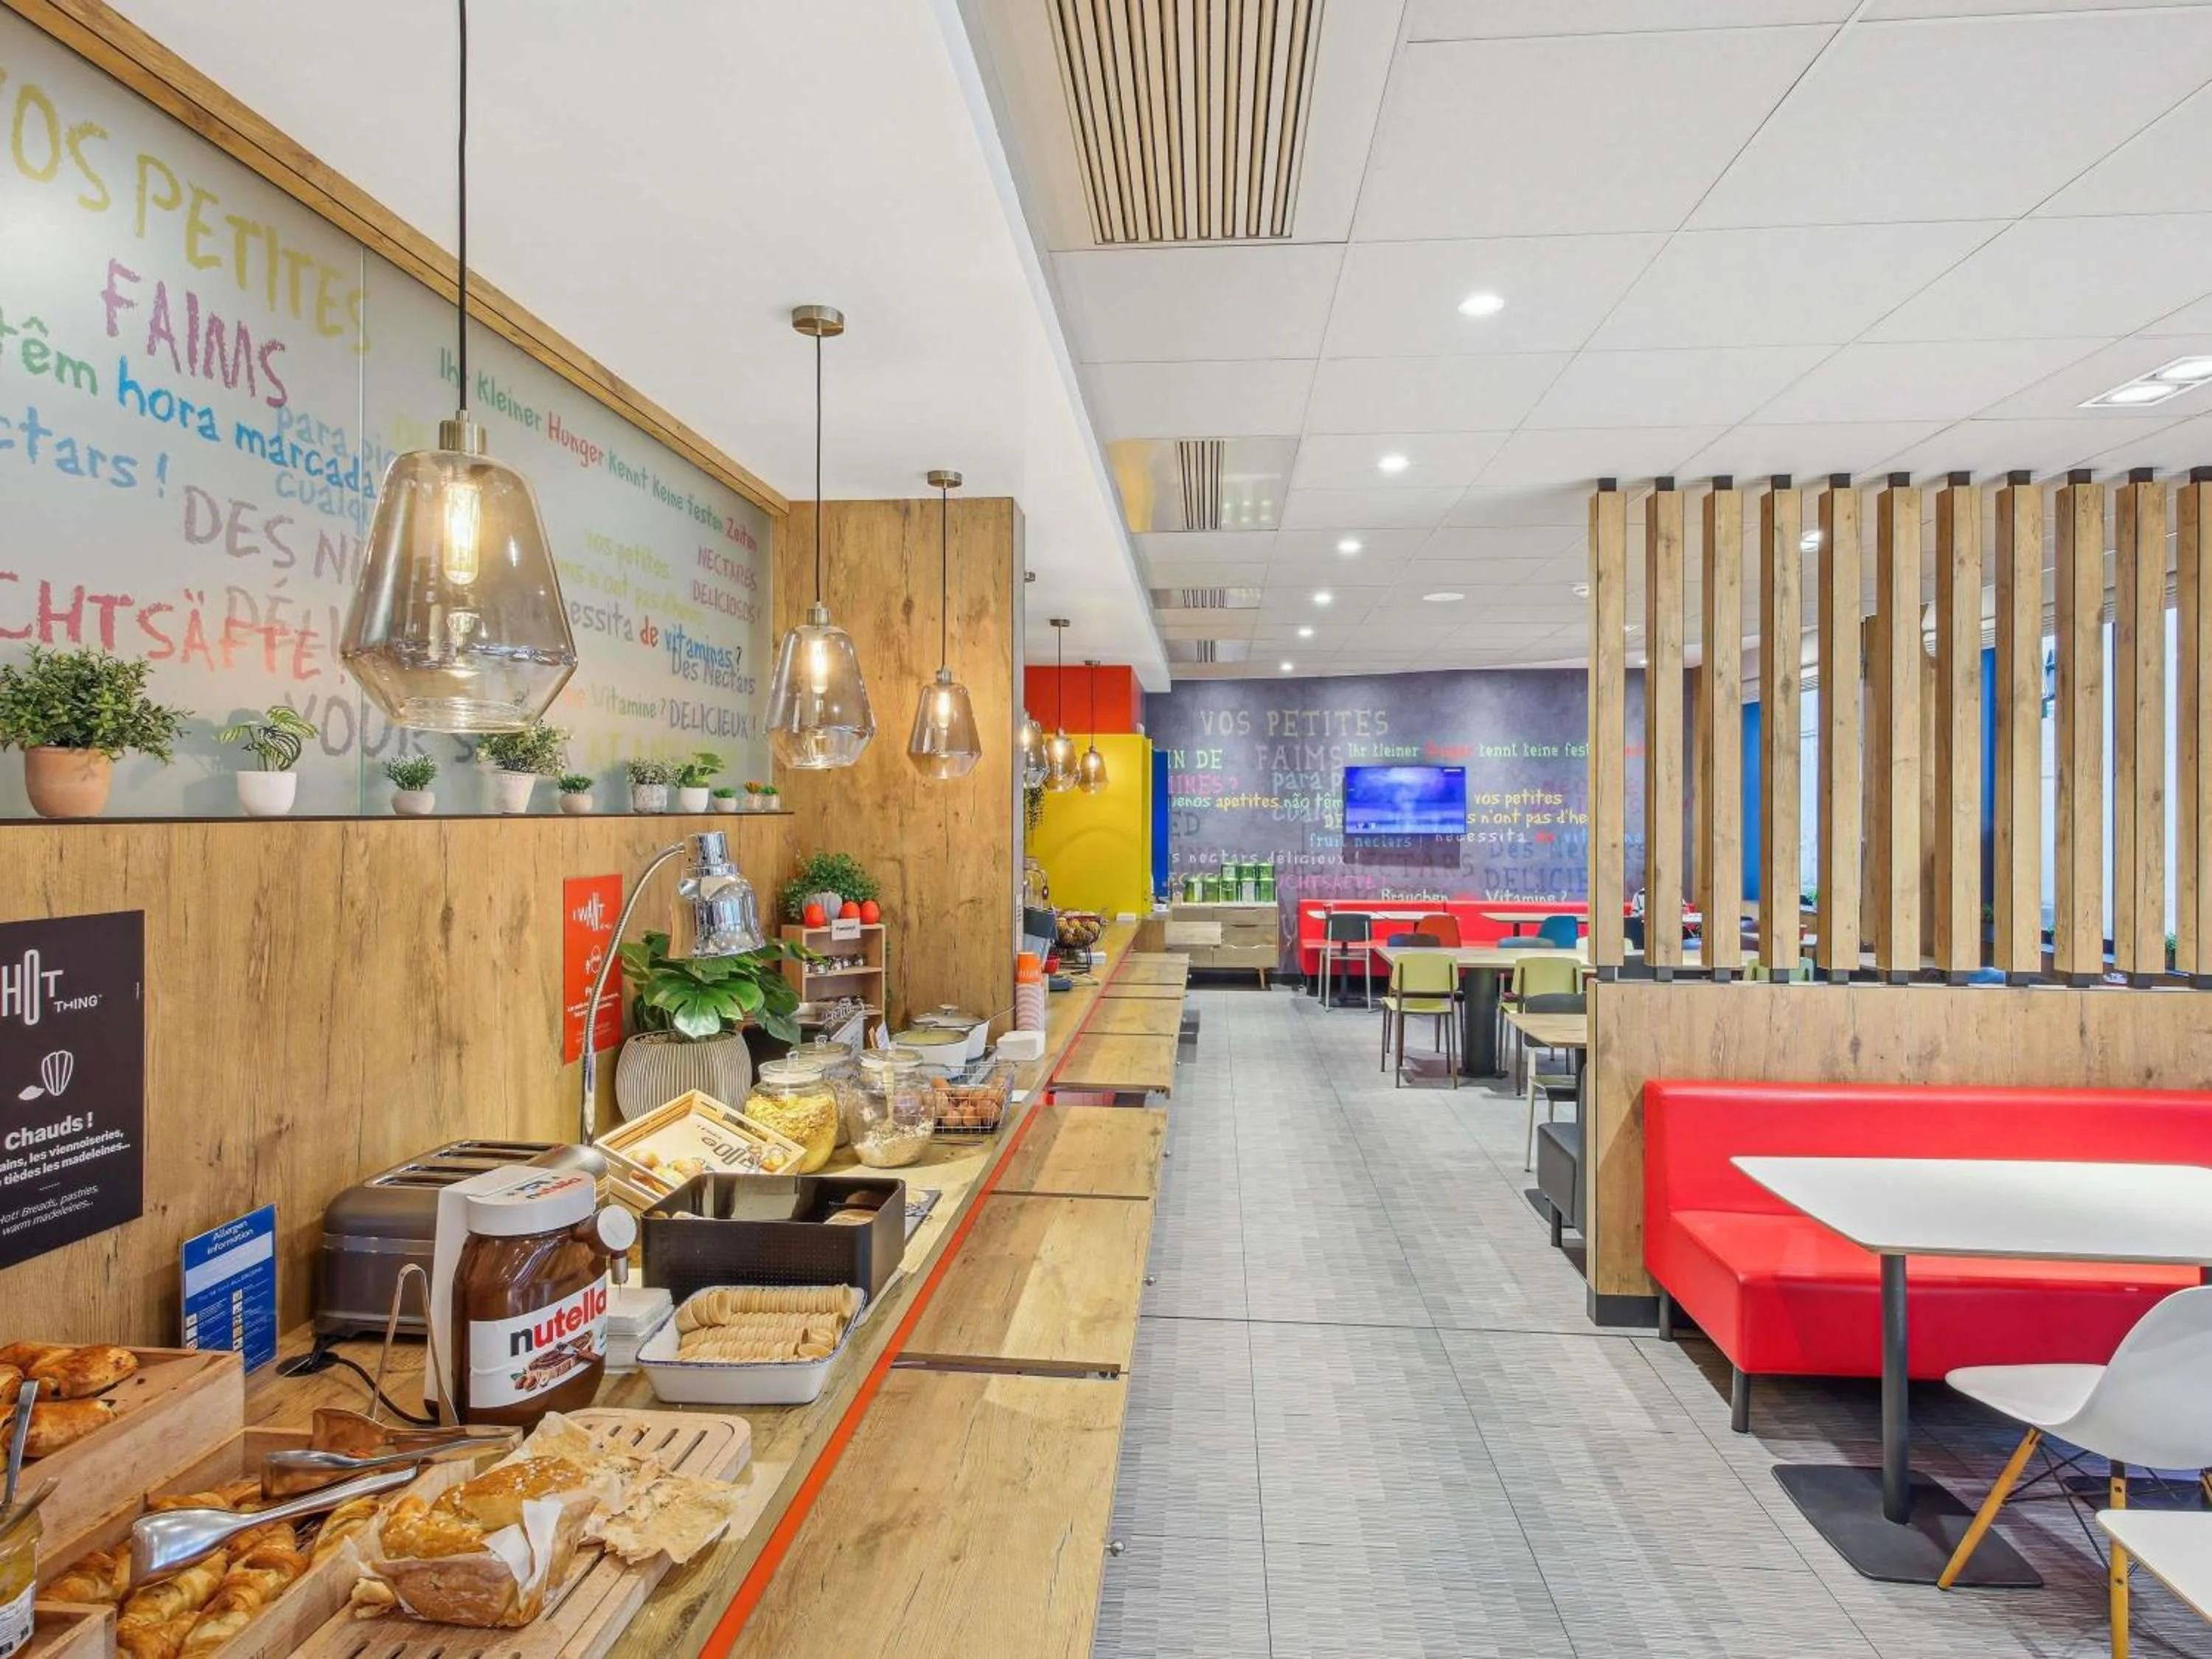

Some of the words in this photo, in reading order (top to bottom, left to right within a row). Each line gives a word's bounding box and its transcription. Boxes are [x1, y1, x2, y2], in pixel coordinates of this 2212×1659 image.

[0, 66, 112, 212] OS
[134, 153, 371, 355] PETITES
[101, 257, 288, 408] FAIMS
[118, 355, 220, 442] hora
[234, 421, 378, 499] marcada
[548, 411, 605, 468] Hunger
[184, 484, 296, 568] DES
[639, 613, 659, 647] de
[1200, 711, 1251, 736] VOS
[1266, 709, 1389, 737] PETITES
[1195, 749, 1223, 769] DE
[1255, 743, 1344, 771] FAIMS
[1505, 788, 1563, 808] petites
[1525, 813, 1552, 827] pas
[1, 949, 64, 1026] HOT
[5, 1114, 84, 1151] Chauds
[29, 1150, 47, 1164] les
[49, 1129, 125, 1156] viennoiseries,
[42, 1161, 60, 1174] les
[509, 1287, 607, 1357] nutella
